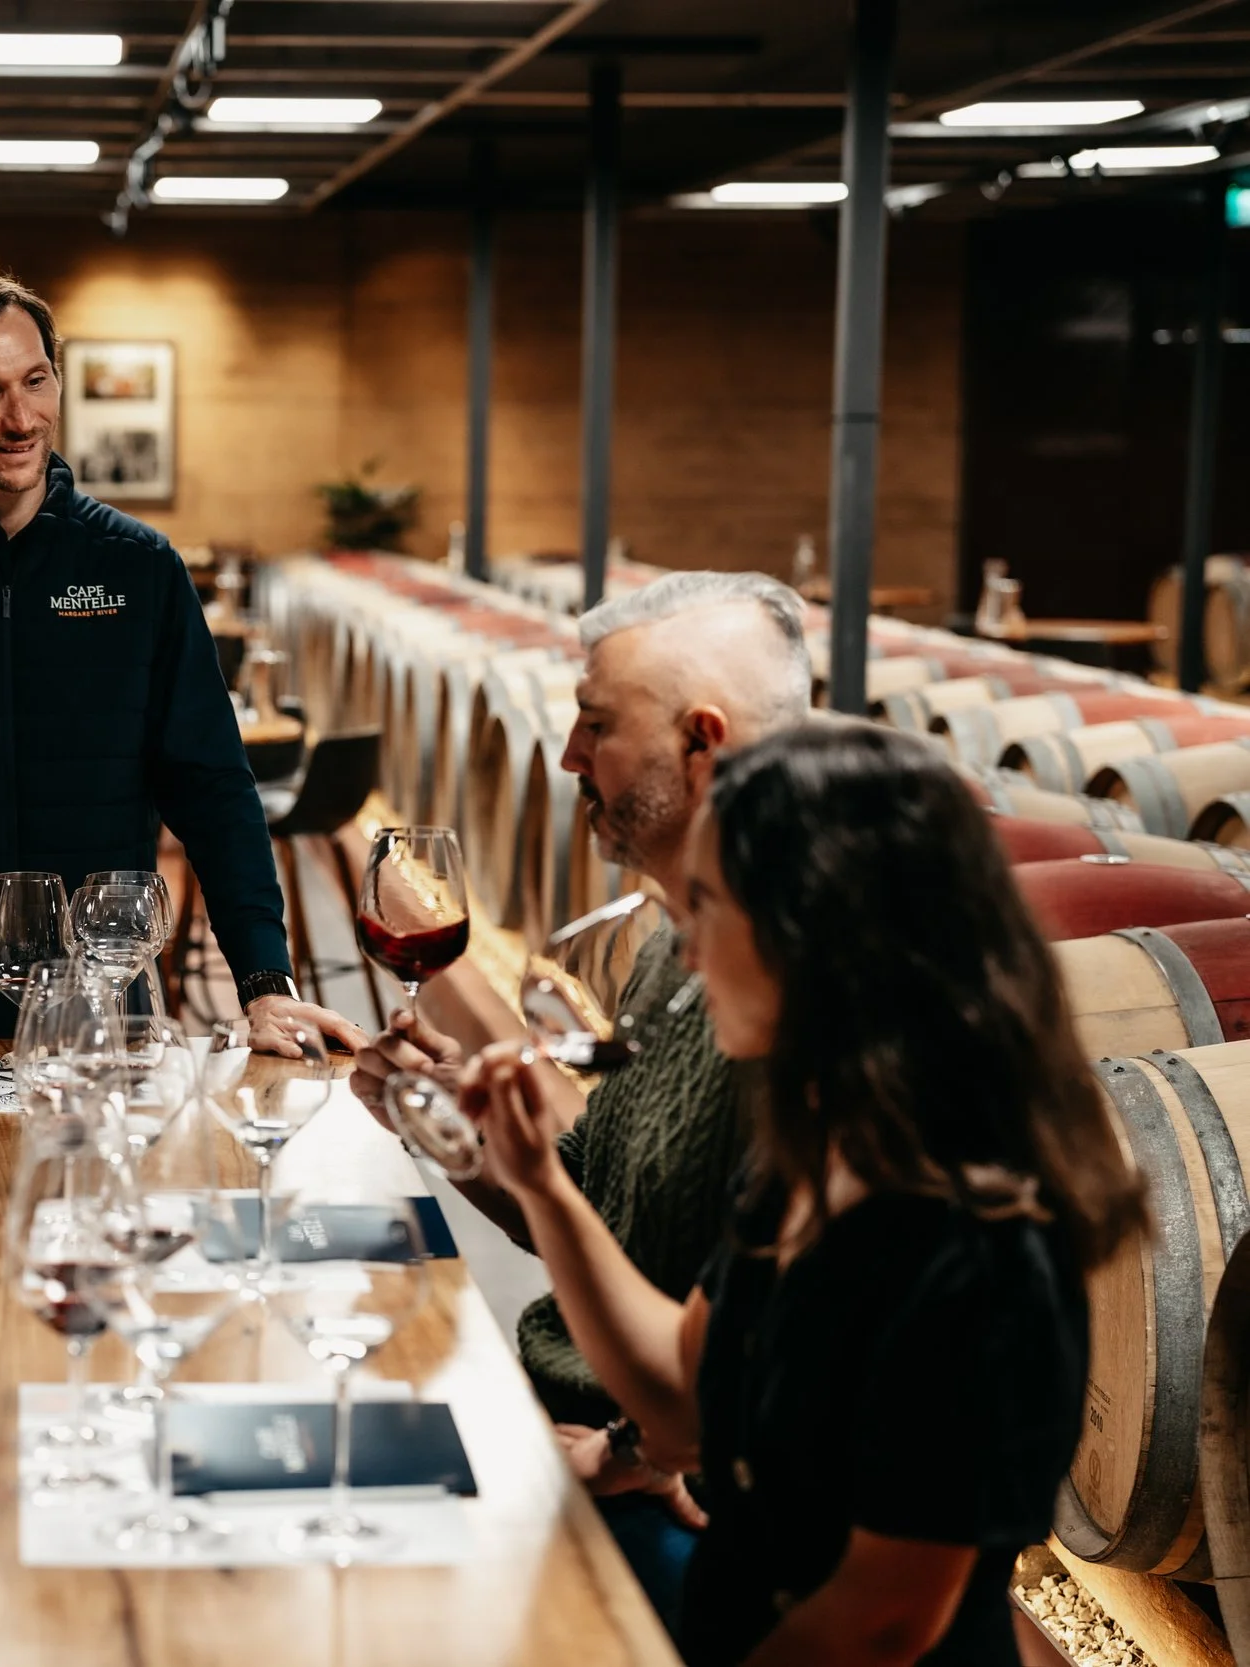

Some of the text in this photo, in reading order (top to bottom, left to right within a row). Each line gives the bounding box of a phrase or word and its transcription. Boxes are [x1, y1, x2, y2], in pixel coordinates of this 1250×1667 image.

[66, 585, 105, 598] CAPE
[50, 594, 126, 610] MENTELLE
[96, 608, 118, 616] RIVER
